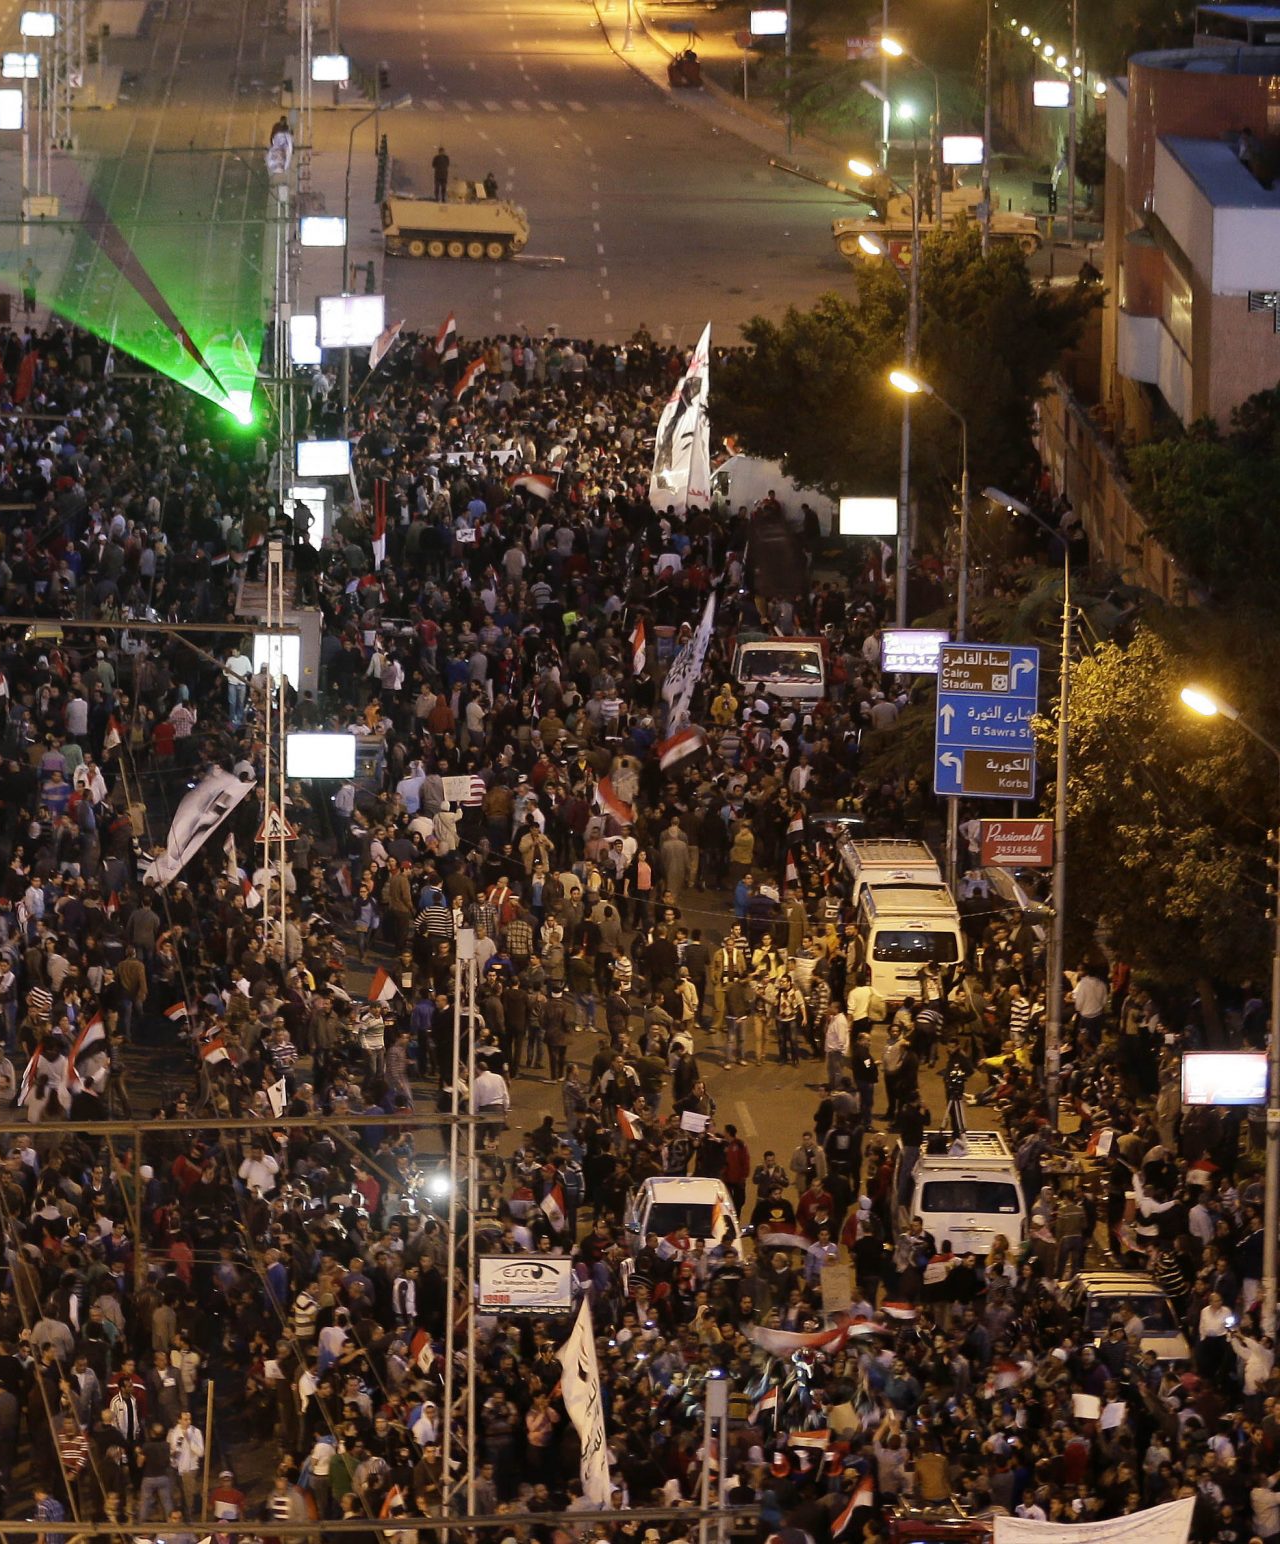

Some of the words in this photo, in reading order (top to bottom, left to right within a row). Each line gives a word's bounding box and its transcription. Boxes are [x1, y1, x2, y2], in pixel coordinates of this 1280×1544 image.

[942, 652, 982, 667] القاهرة
[983, 652, 1008, 666] ستاد
[942, 668, 970, 678] Cairo
[942, 679, 984, 690] Stadium
[968, 706, 1001, 720] الثورة
[971, 726, 980, 735] El
[984, 727, 1016, 737] Sawra
[986, 758, 1030, 773] الكوربة
[999, 778, 1028, 789] Korba
[985, 824, 1046, 842] Passionelle
